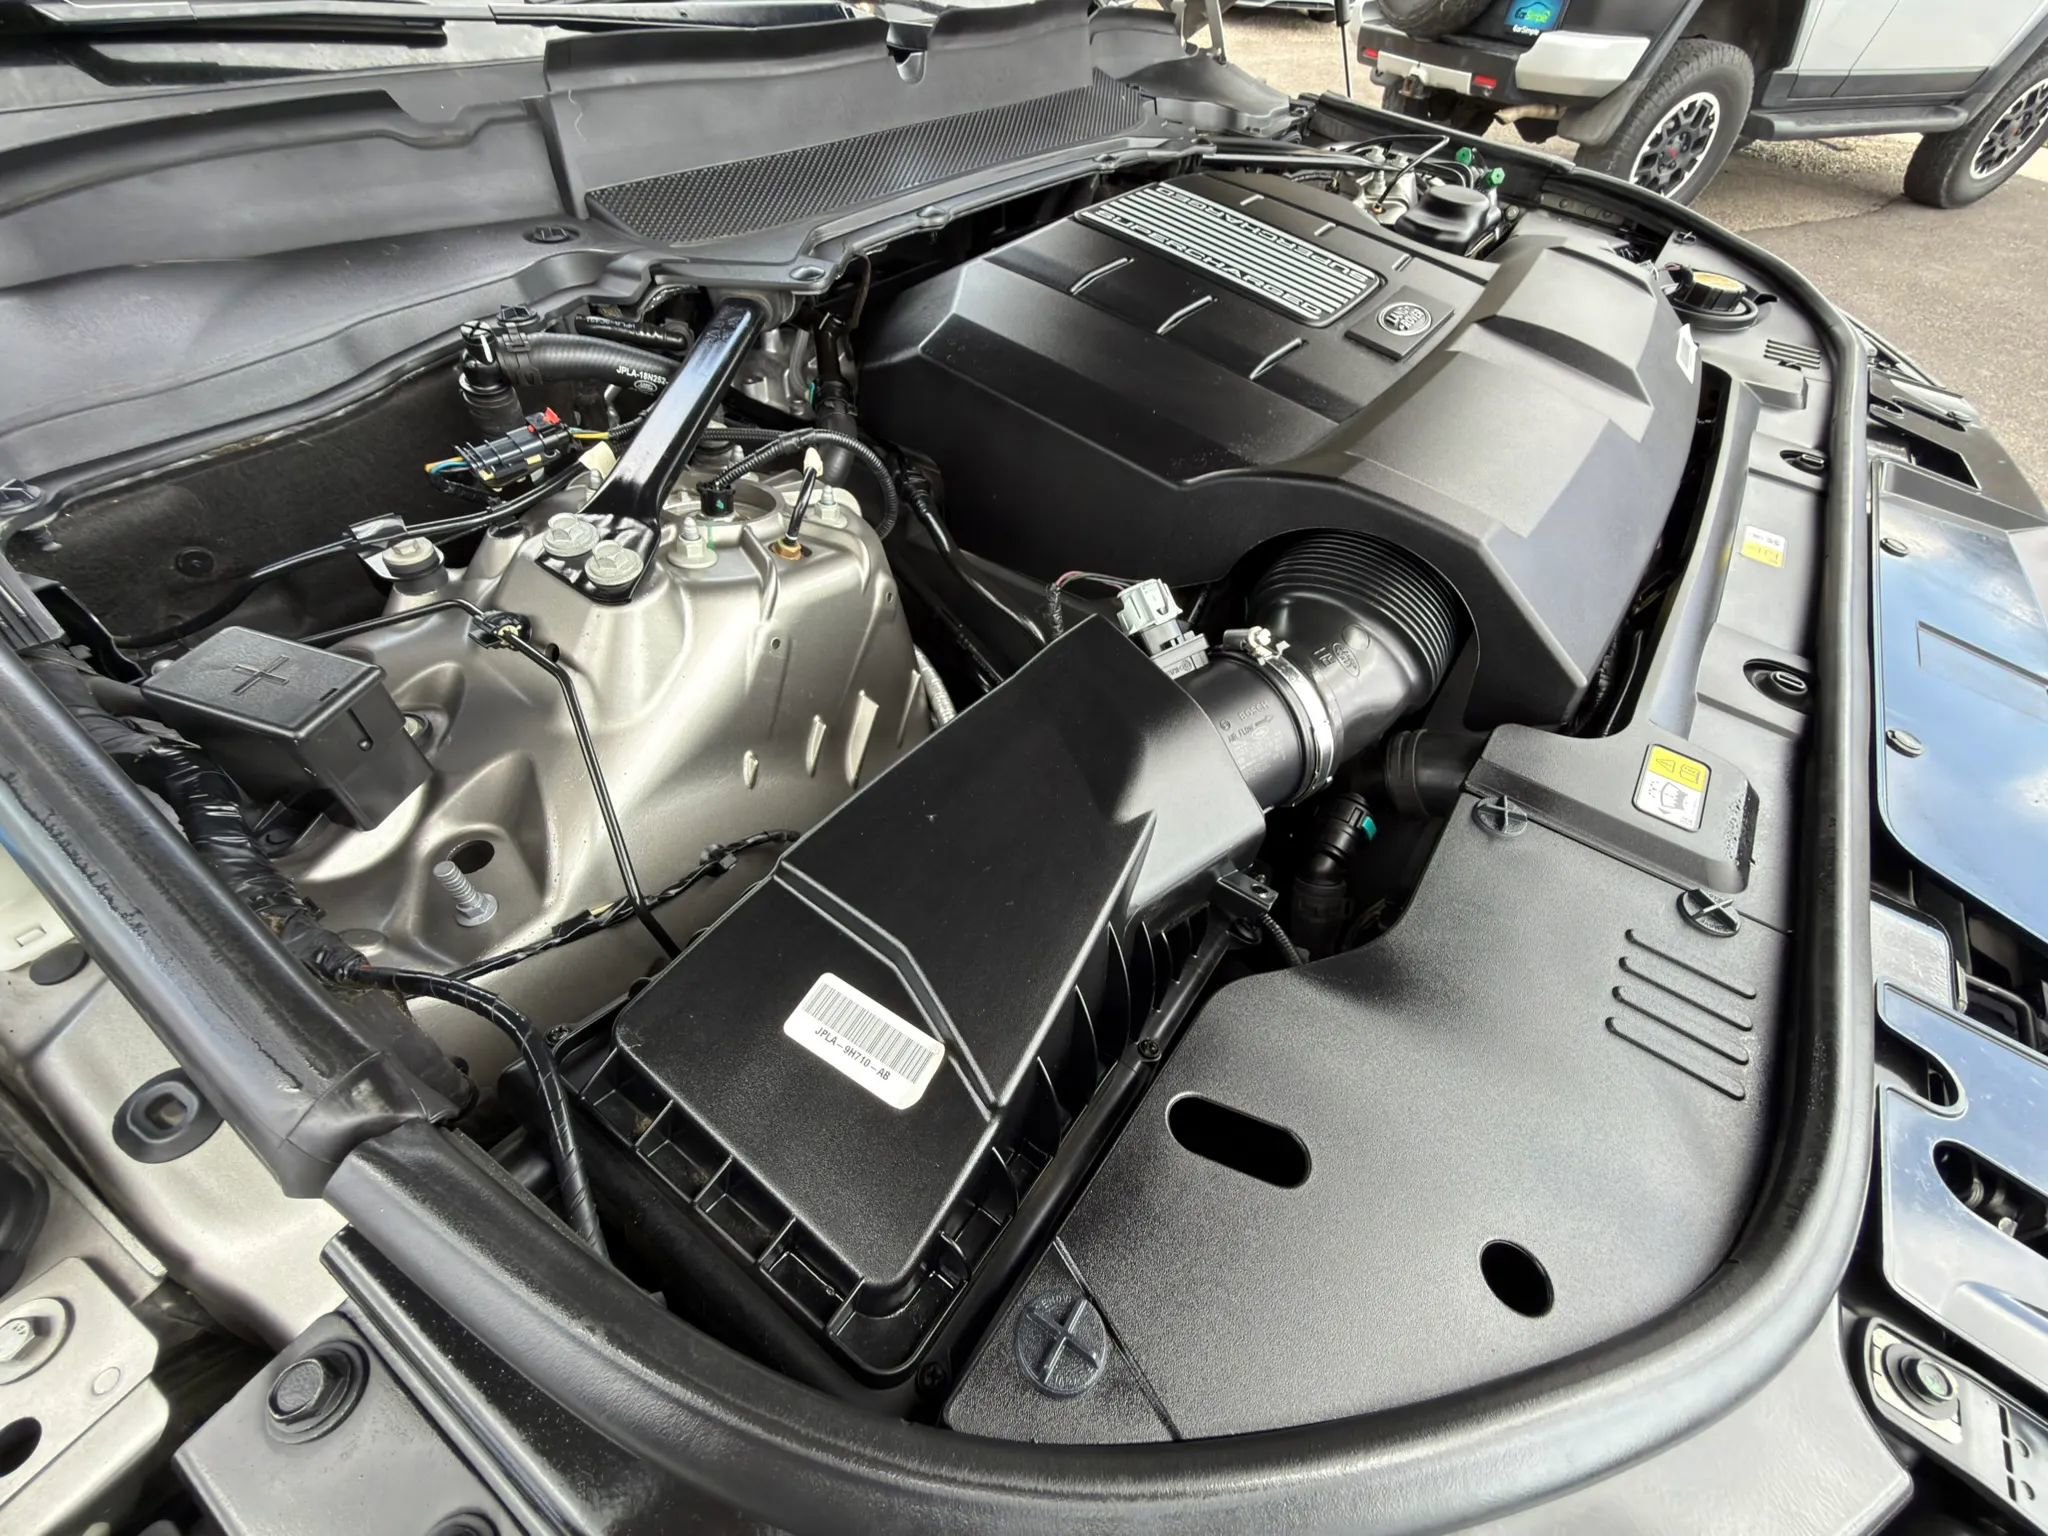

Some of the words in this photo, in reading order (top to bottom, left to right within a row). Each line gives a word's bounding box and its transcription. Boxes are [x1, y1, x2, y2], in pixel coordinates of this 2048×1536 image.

[1094, 210, 1322, 316] SUPERCHARGED
[1155, 186, 1369, 283] SUPERCHARGED
[1238, 700, 1270, 721] BOSCH
[814, 1027, 892, 1081] JPLA-9H710-AB
